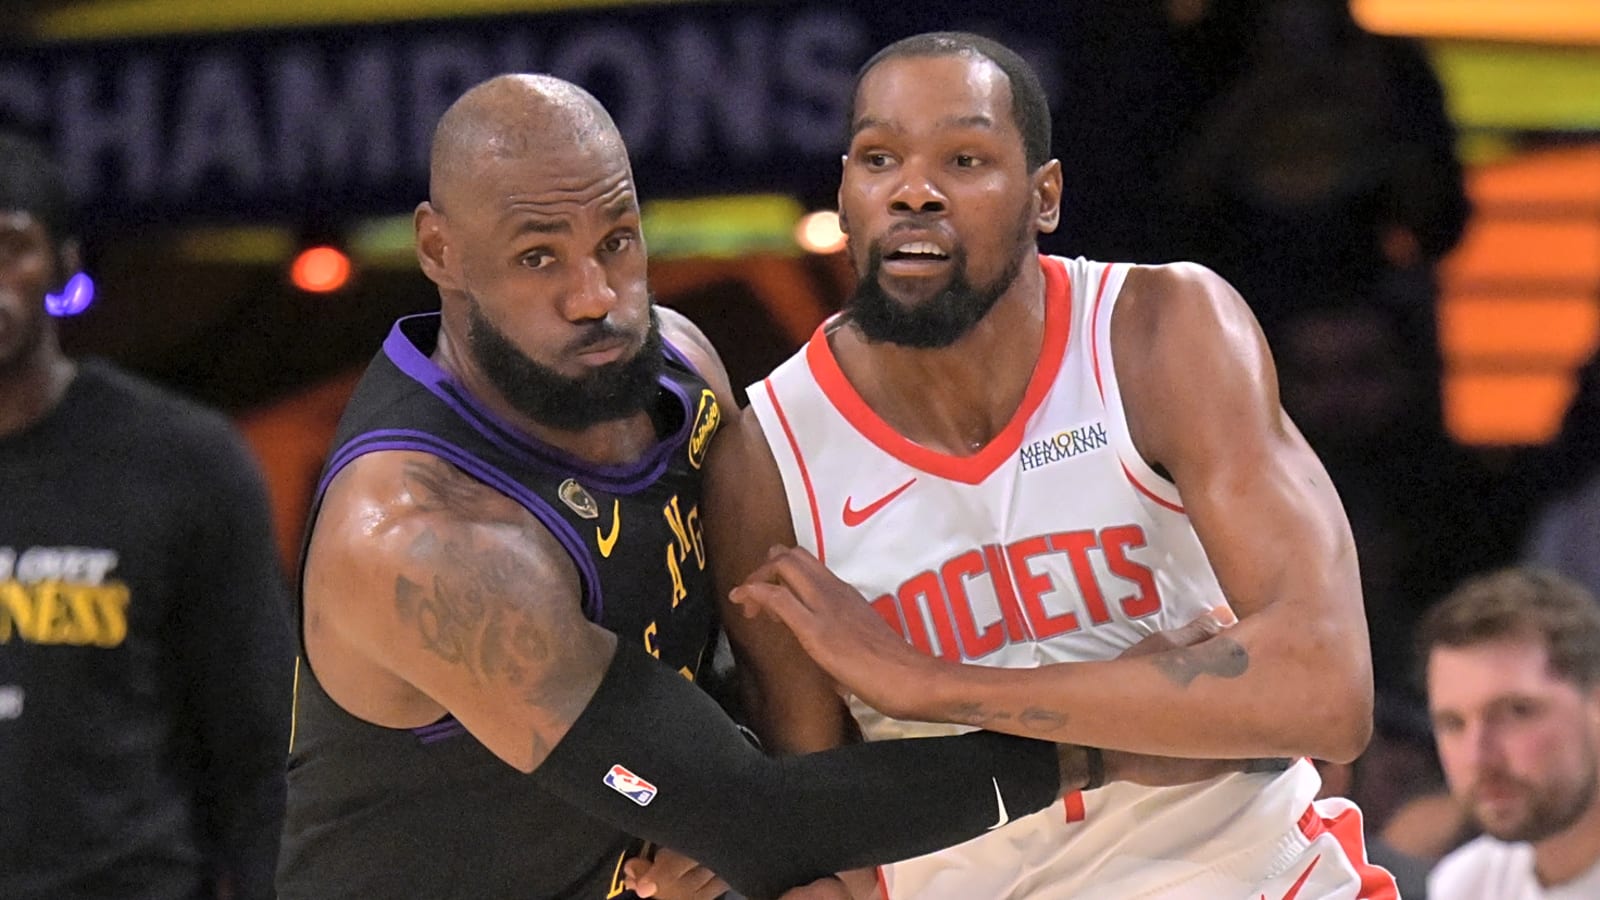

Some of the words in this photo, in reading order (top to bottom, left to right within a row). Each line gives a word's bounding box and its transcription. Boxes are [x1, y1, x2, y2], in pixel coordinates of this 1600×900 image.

[0, 12, 862, 196] HAMPONS
[1020, 422, 1106, 460] MEMORIAL
[1020, 430, 1108, 472] HERMANN
